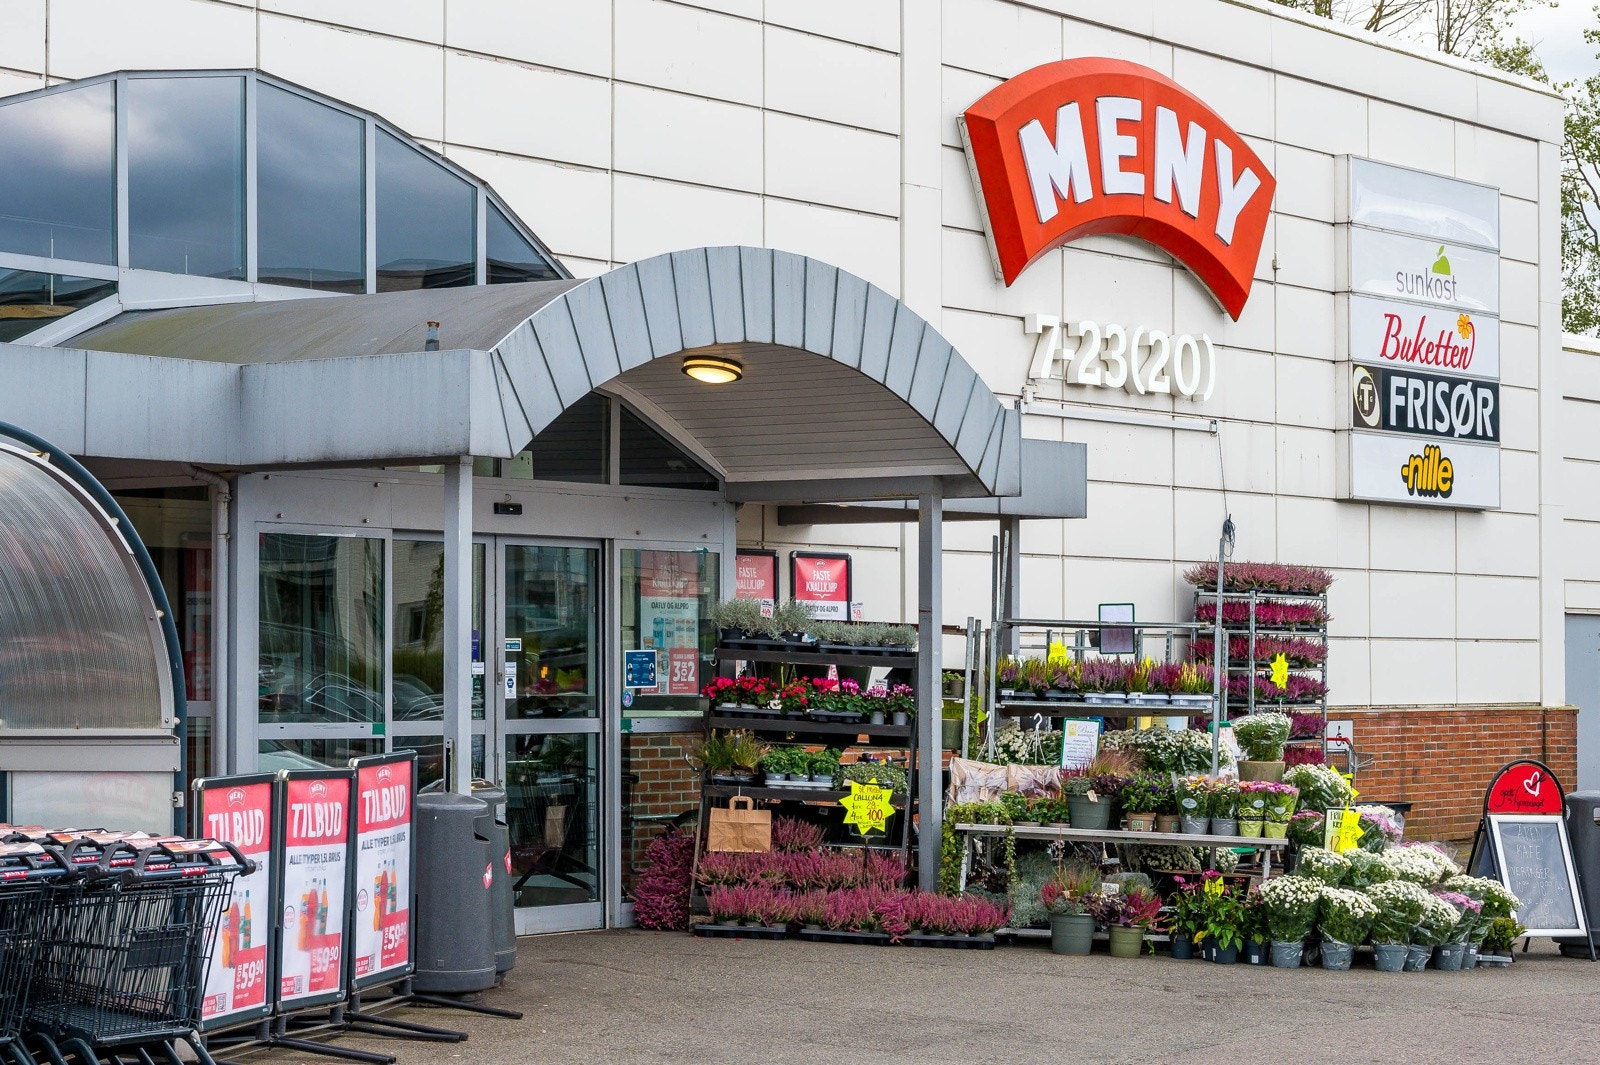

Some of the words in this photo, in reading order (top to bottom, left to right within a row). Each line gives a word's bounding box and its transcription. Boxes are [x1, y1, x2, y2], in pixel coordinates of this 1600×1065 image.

[1018, 96, 1261, 246] MENY
[1396, 268, 1458, 302] sunkost
[1379, 313, 1476, 370] Buketten
[1025, 313, 1216, 402] 7-23(20)
[1389, 375, 1494, 437] FRISØR
[1401, 444, 1454, 498] nille
[738, 567, 758, 578] FASTE
[812, 570, 831, 580] FASTE
[736, 579, 765, 590] NALLKJØP
[805, 581, 838, 593] KNALLKJØP
[667, 602, 675, 610] OG
[826, 605, 839, 614] ALPRO
[672, 661, 681, 682] 3
[688, 661, 696, 682] 2
[311, 783, 326, 793] MENY
[362, 784, 406, 825] TILBUD
[208, 808, 265, 847] TILBUD
[292, 802, 342, 838] TILBUD
[361, 839, 374, 851] ALLE
[374, 836, 390, 848] TYPER
[289, 854, 302, 866] ALLE
[302, 853, 320, 864] TYPER
[328, 851, 341, 862] BRUS
